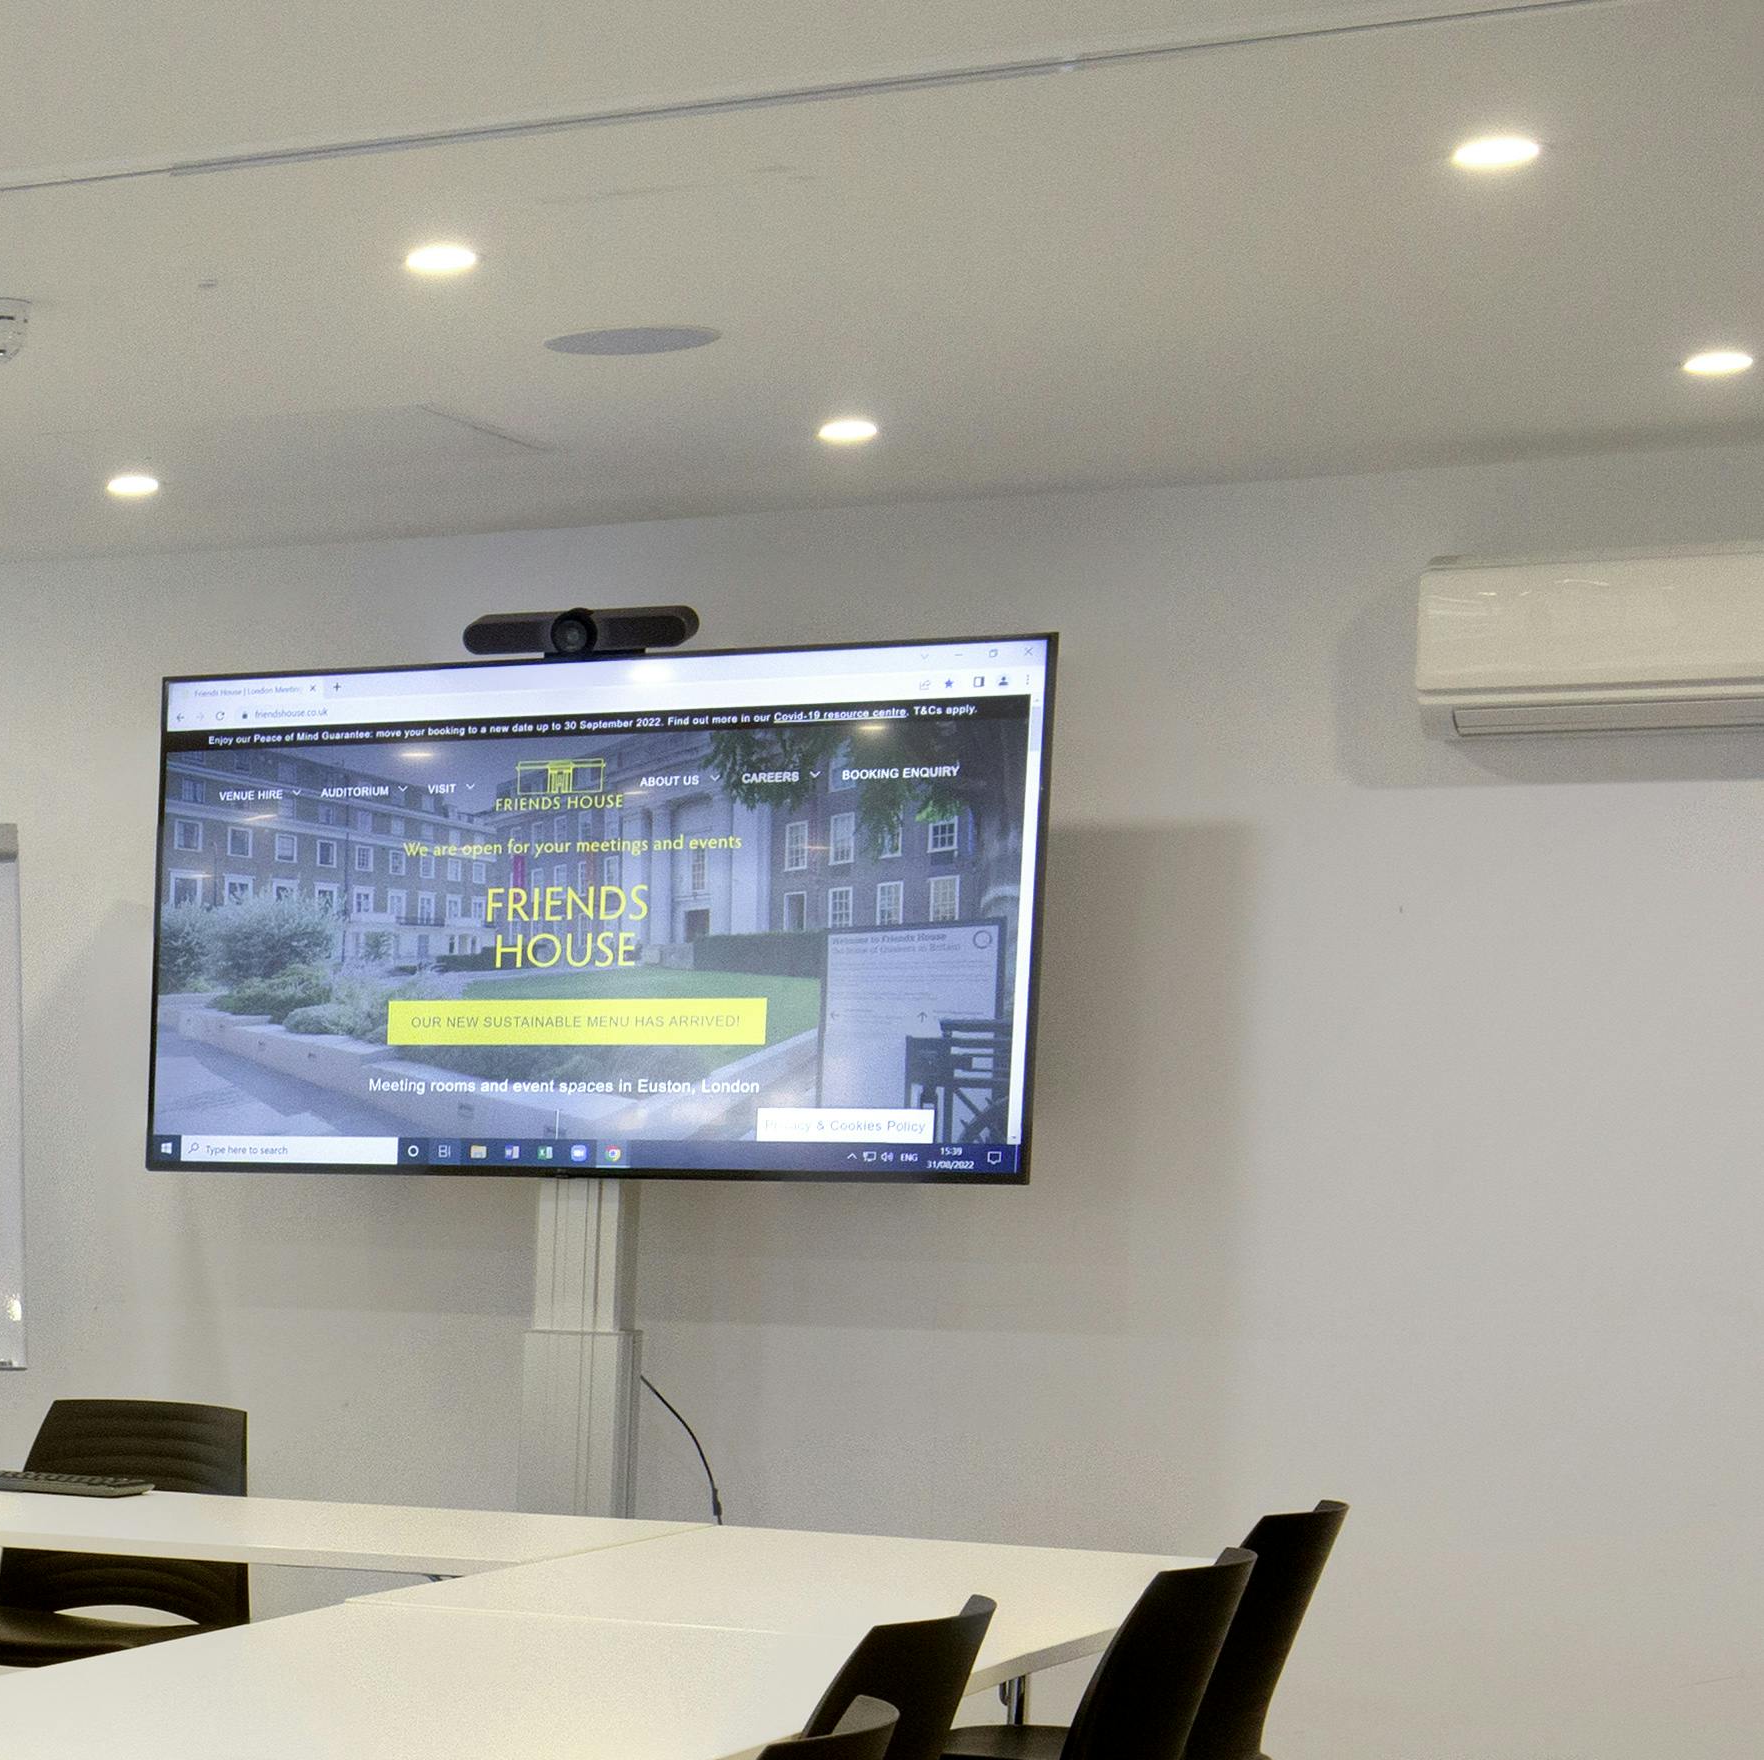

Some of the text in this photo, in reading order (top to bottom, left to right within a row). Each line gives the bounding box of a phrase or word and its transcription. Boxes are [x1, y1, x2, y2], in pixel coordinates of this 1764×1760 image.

[275, 686, 300, 694] Meetin
[254, 708, 328, 719] friendshouse.co.uk
[208, 735, 233, 746] Enjoy
[235, 736, 251, 744] our
[253, 733, 282, 743] Peace
[284, 732, 295, 742] of
[296, 732, 319, 741] Mind
[321, 730, 373, 741] Guarantee:
[376, 729, 402, 738] move
[404, 728, 425, 739] your
[428, 725, 465, 738] booking
[468, 725, 478, 734] to
[512, 722, 533, 732] date
[536, 724, 548, 734] up
[551, 722, 561, 731] to
[564, 721, 577, 730] 30
[580, 719, 633, 732] September
[636, 717, 664, 728] 2022.
[667, 715, 689, 726] Find
[692, 716, 709, 726] out
[712, 715, 738, 724] more
[740, 713, 751, 723] in
[753, 714, 771, 723] our
[773, 710, 821, 722] Covid-19
[823, 709, 869, 720] resource
[872, 706, 909, 718] centre.
[913, 705, 943, 716] T&Cs
[945, 703, 978, 716] apply.
[741, 771, 800, 784] CAREERS
[841, 765, 960, 781] BOOKING ENQUIRY
[639, 774, 700, 787] ABOUT US
[218, 788, 284, 801] VENUE HIRE
[320, 785, 389, 798] AUDITORIUM
[427, 783, 457, 795] VISIT
[495, 794, 623, 812] FRIENDS HOUSE
[403, 834, 743, 860] We are open for your meetings and events
[486, 884, 649, 923] FRIENDS
[494, 932, 636, 969] HOUSE
[410, 1014, 741, 1029] OUR NEW SUSTAINABLE MENU HAS ARRIVED!
[369, 1078, 760, 1096] Meeting rooms and event spaces in Euston, London
[764, 1119, 926, 1134] Pracy & Cookies Policy
[205, 1144, 288, 1156] Type here to search
[900, 1152, 918, 1163] ENG
[925, 1159, 975, 1170] 31/08/2022
